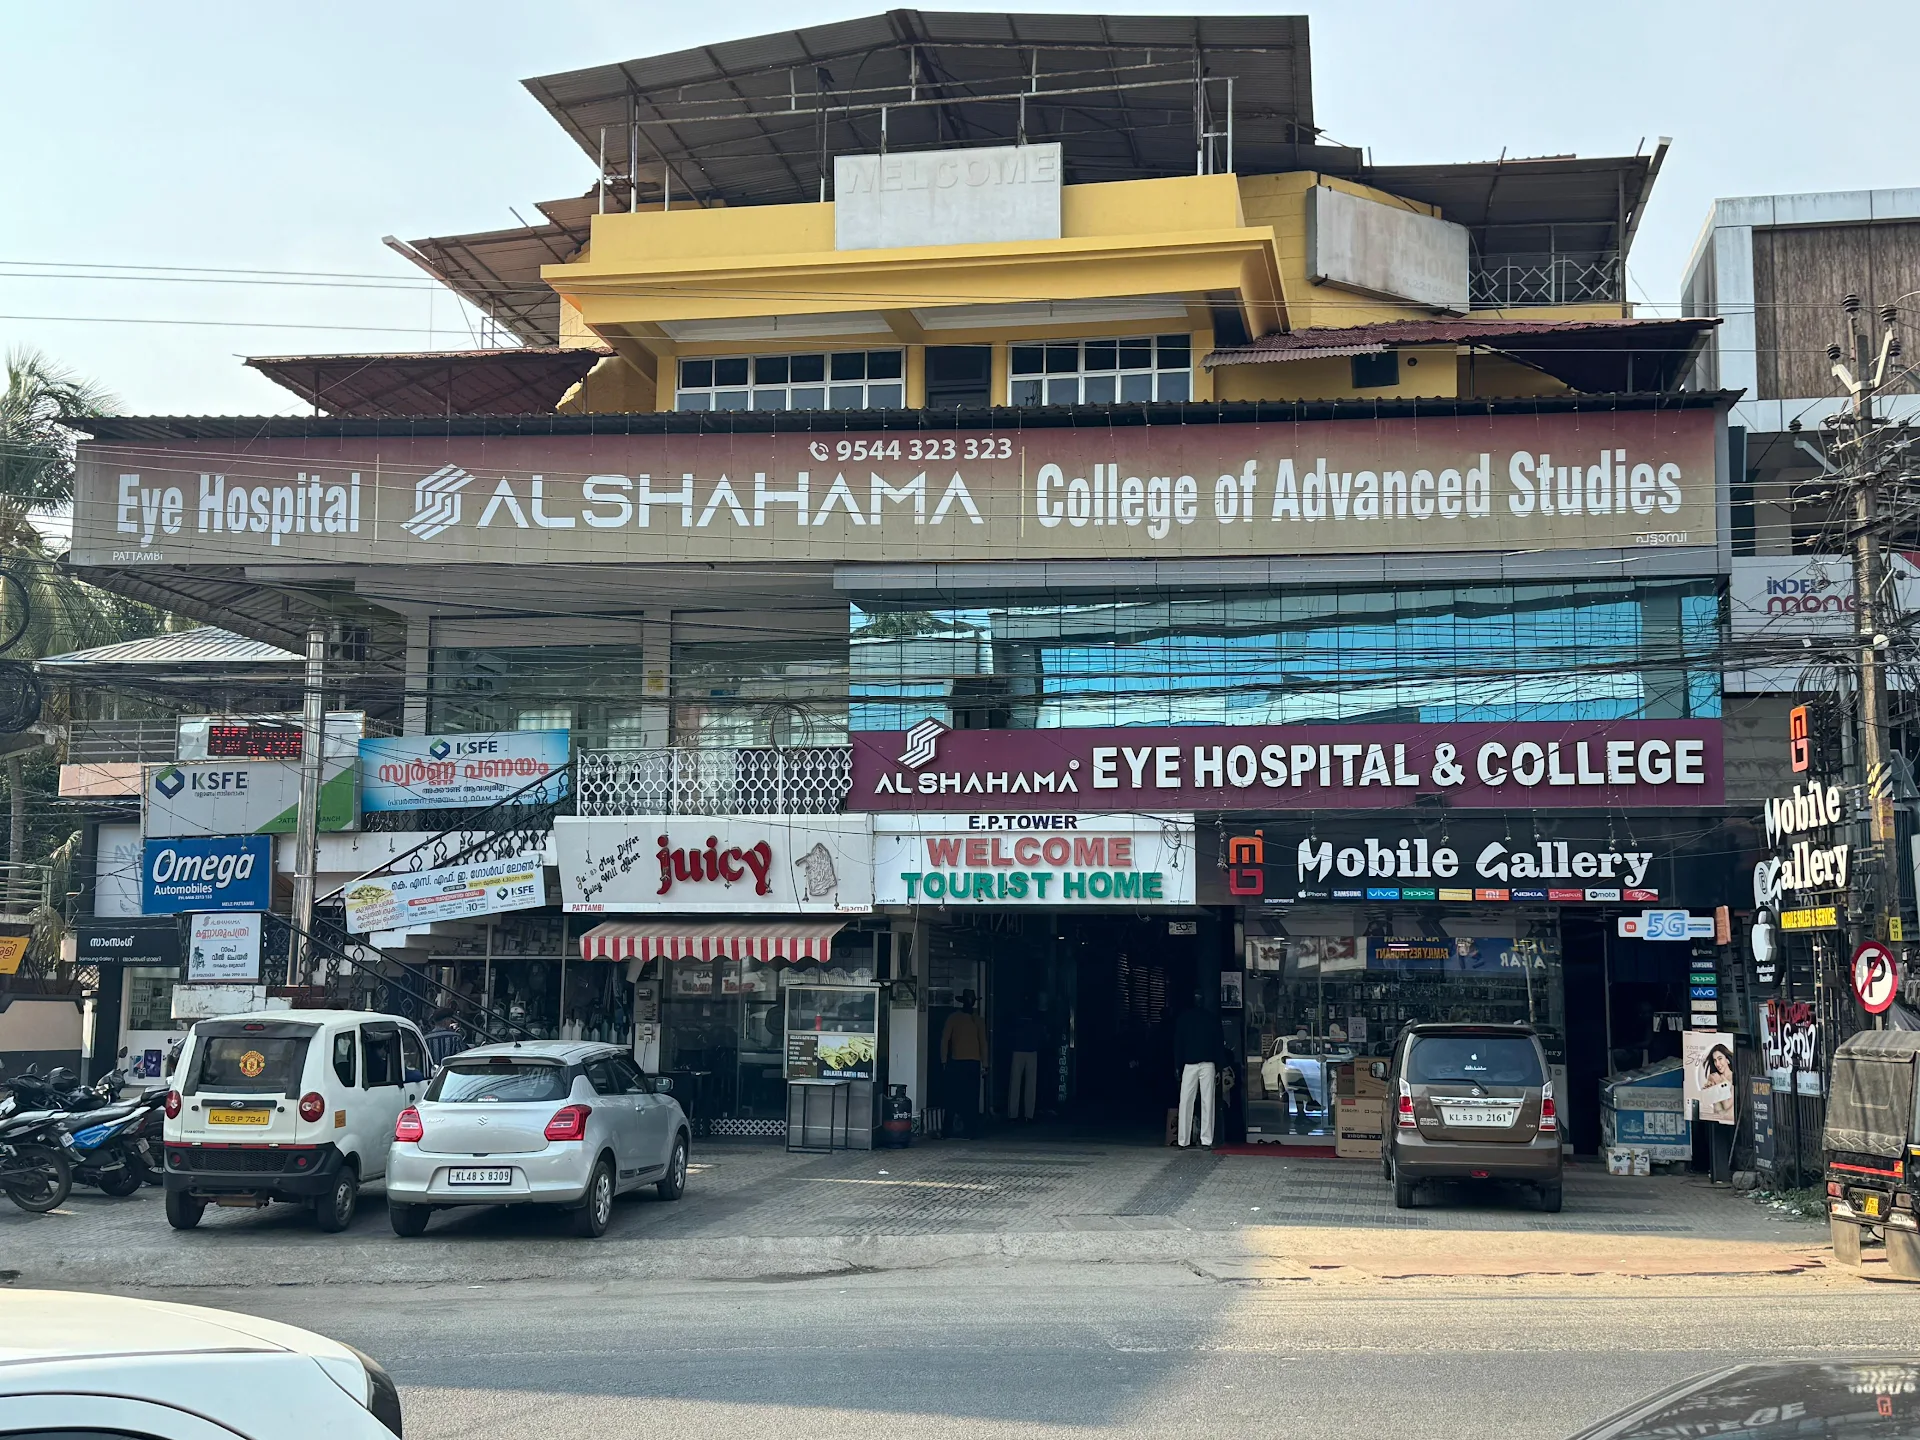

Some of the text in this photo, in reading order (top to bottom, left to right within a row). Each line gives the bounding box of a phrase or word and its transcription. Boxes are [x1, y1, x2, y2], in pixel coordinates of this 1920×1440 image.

[845, 152, 1056, 194] WELCOME
[836, 438, 1012, 462] 9544 323 323
[1037, 449, 1682, 540] College of Advanced Studies
[116, 472, 361, 548] Eye Hospital
[1635, 530, 1687, 545] പട്ടാമ്പി
[112, 551, 164, 561] PATTAMBI
[456, 740, 498, 754] KSFE
[464, 757, 549, 778] പണയം
[1092, 739, 1705, 789] EYE HOSPITAL & COLLEGE
[192, 771, 248, 789] KSFE
[968, 814, 1078, 830] E.P.TOWER
[1764, 780, 1841, 850] Mobile
[598, 855, 615, 872] May
[616, 836, 640, 860] Differ
[926, 837, 1132, 867] WELCOME
[1297, 838, 1653, 887] Mobile Gallery
[152, 848, 256, 888] Omega
[656, 834, 772, 896] juicy
[1767, 840, 1849, 901] Gallery
[153, 884, 213, 896] Automobiles
[511, 885, 534, 896] KSFE
[583, 882, 603, 902] Juicy
[600, 866, 618, 883] Will
[901, 871, 1163, 899] TOURIST HOME
[1403, 890, 1434, 898] oppo
[571, 903, 605, 911] PATTAMBI
[1646, 912, 1686, 938] 5G
[90, 935, 135, 947] സാംസംഗ്
[1691, 961, 1713, 969] SAMSUNG
[1866, 956, 1886, 998] P
[1692, 987, 1715, 997] vivo
[1477, 1114, 1483, 1122] D
[1486, 1113, 1506, 1122] 2161
[455, 1169, 509, 1182] KL48 S 8309
